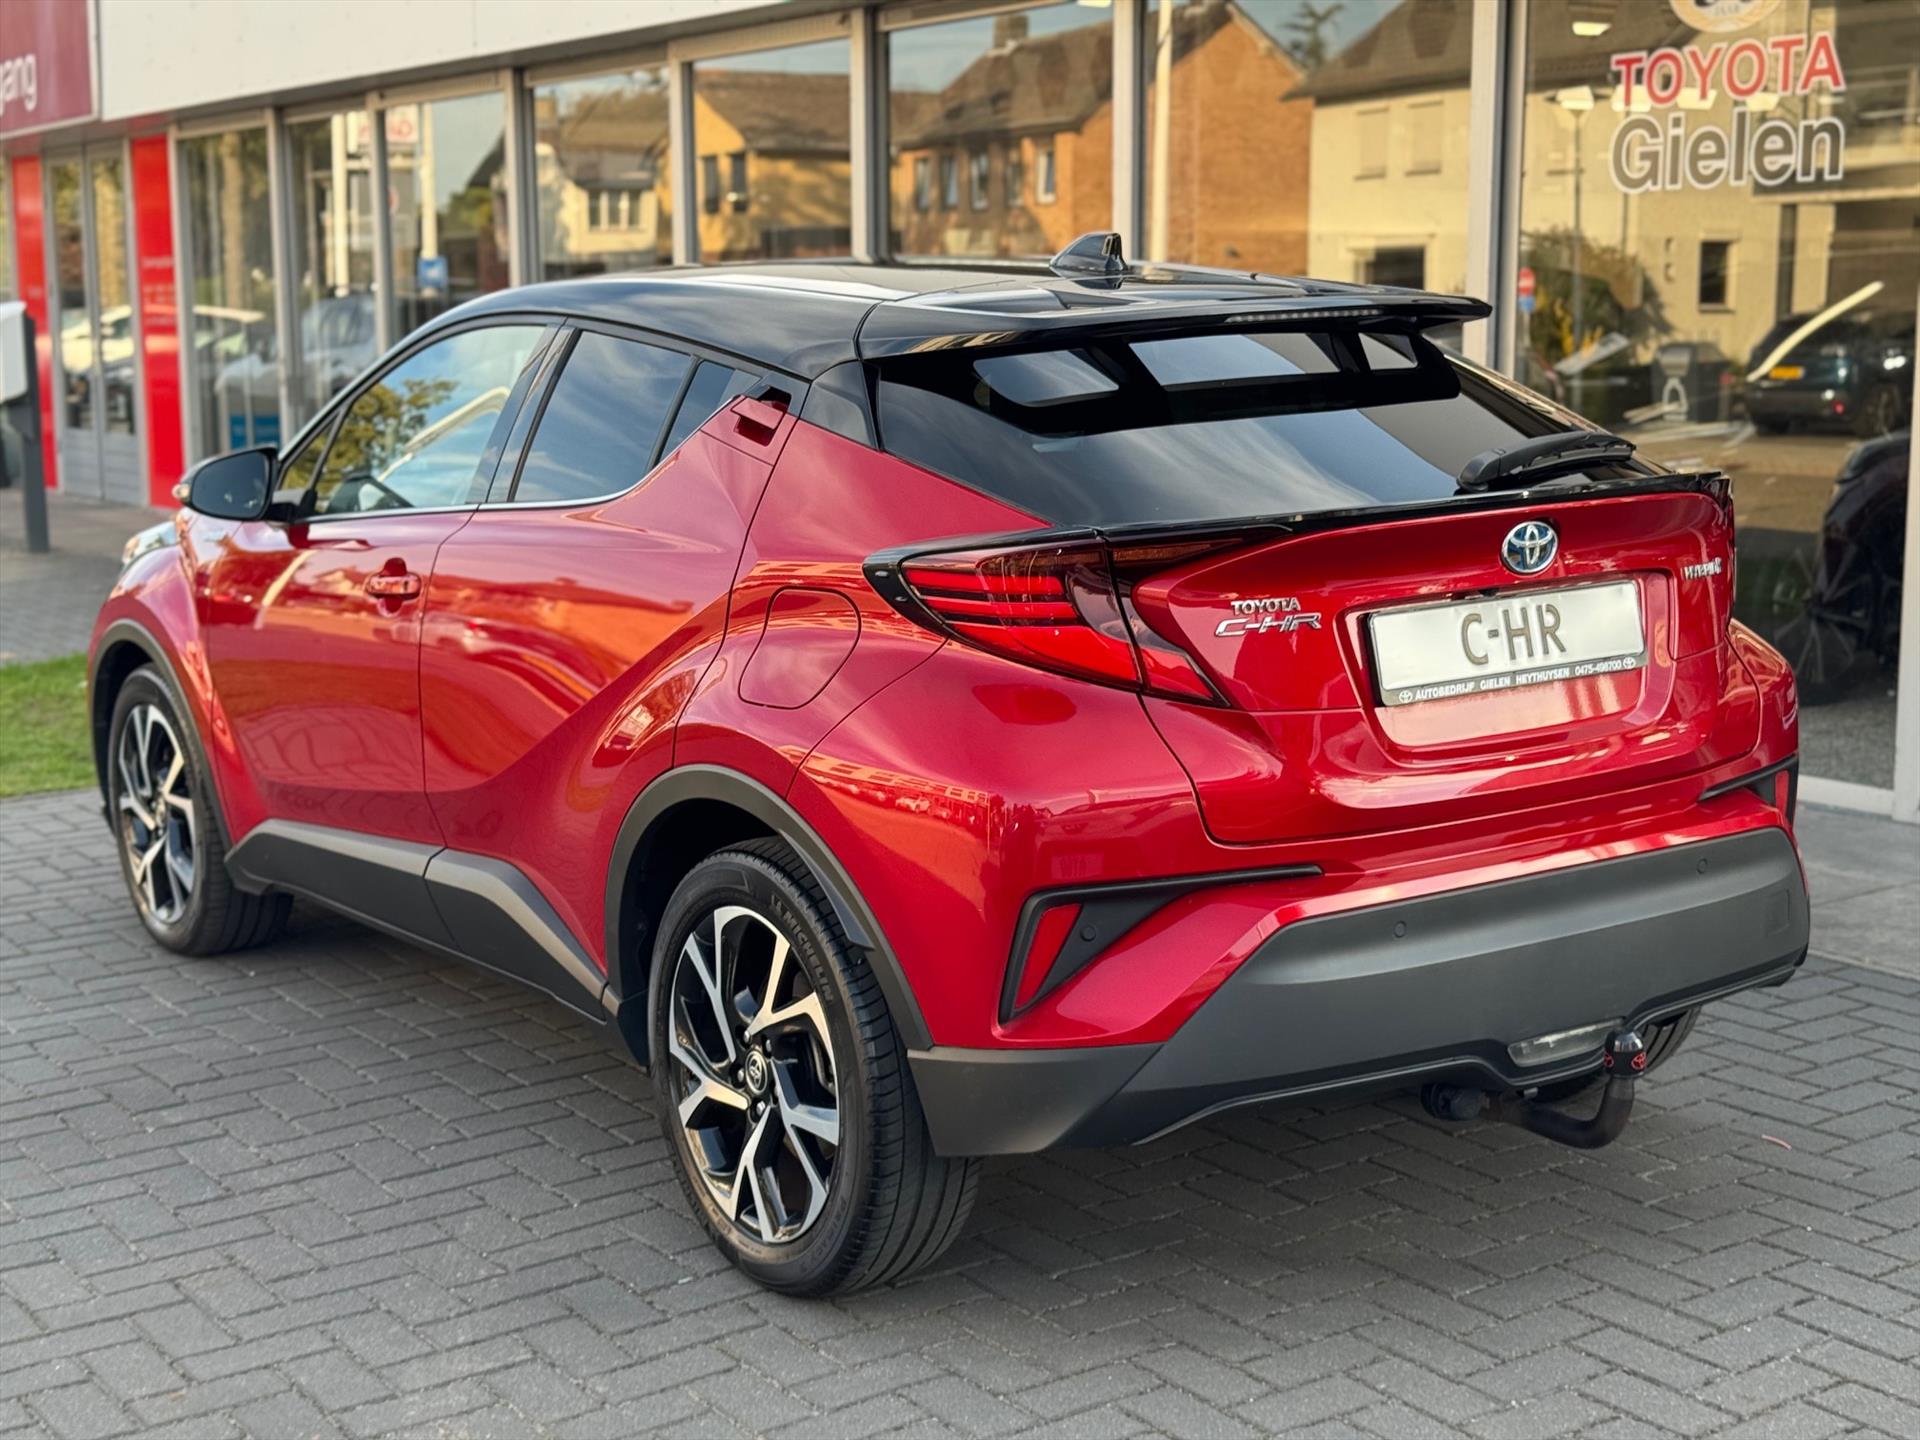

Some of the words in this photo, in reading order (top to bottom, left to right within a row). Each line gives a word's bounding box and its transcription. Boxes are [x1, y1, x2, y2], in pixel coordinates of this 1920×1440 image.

[0, 54, 38, 117] ang
[1611, 32, 1846, 108] TOYOTA
[1610, 108, 1846, 194] Gielen
[1214, 612, 1322, 636] C-HR
[1230, 597, 1301, 615] TOYOTA
[1460, 603, 1567, 666] C-HR
[1415, 681, 1475, 701] AUTOBEDRIJF
[1480, 676, 1511, 691] GIELEN
[1515, 667, 1570, 685] HEYTHUYSEN
[782, 910, 835, 1002] MICHELIN
